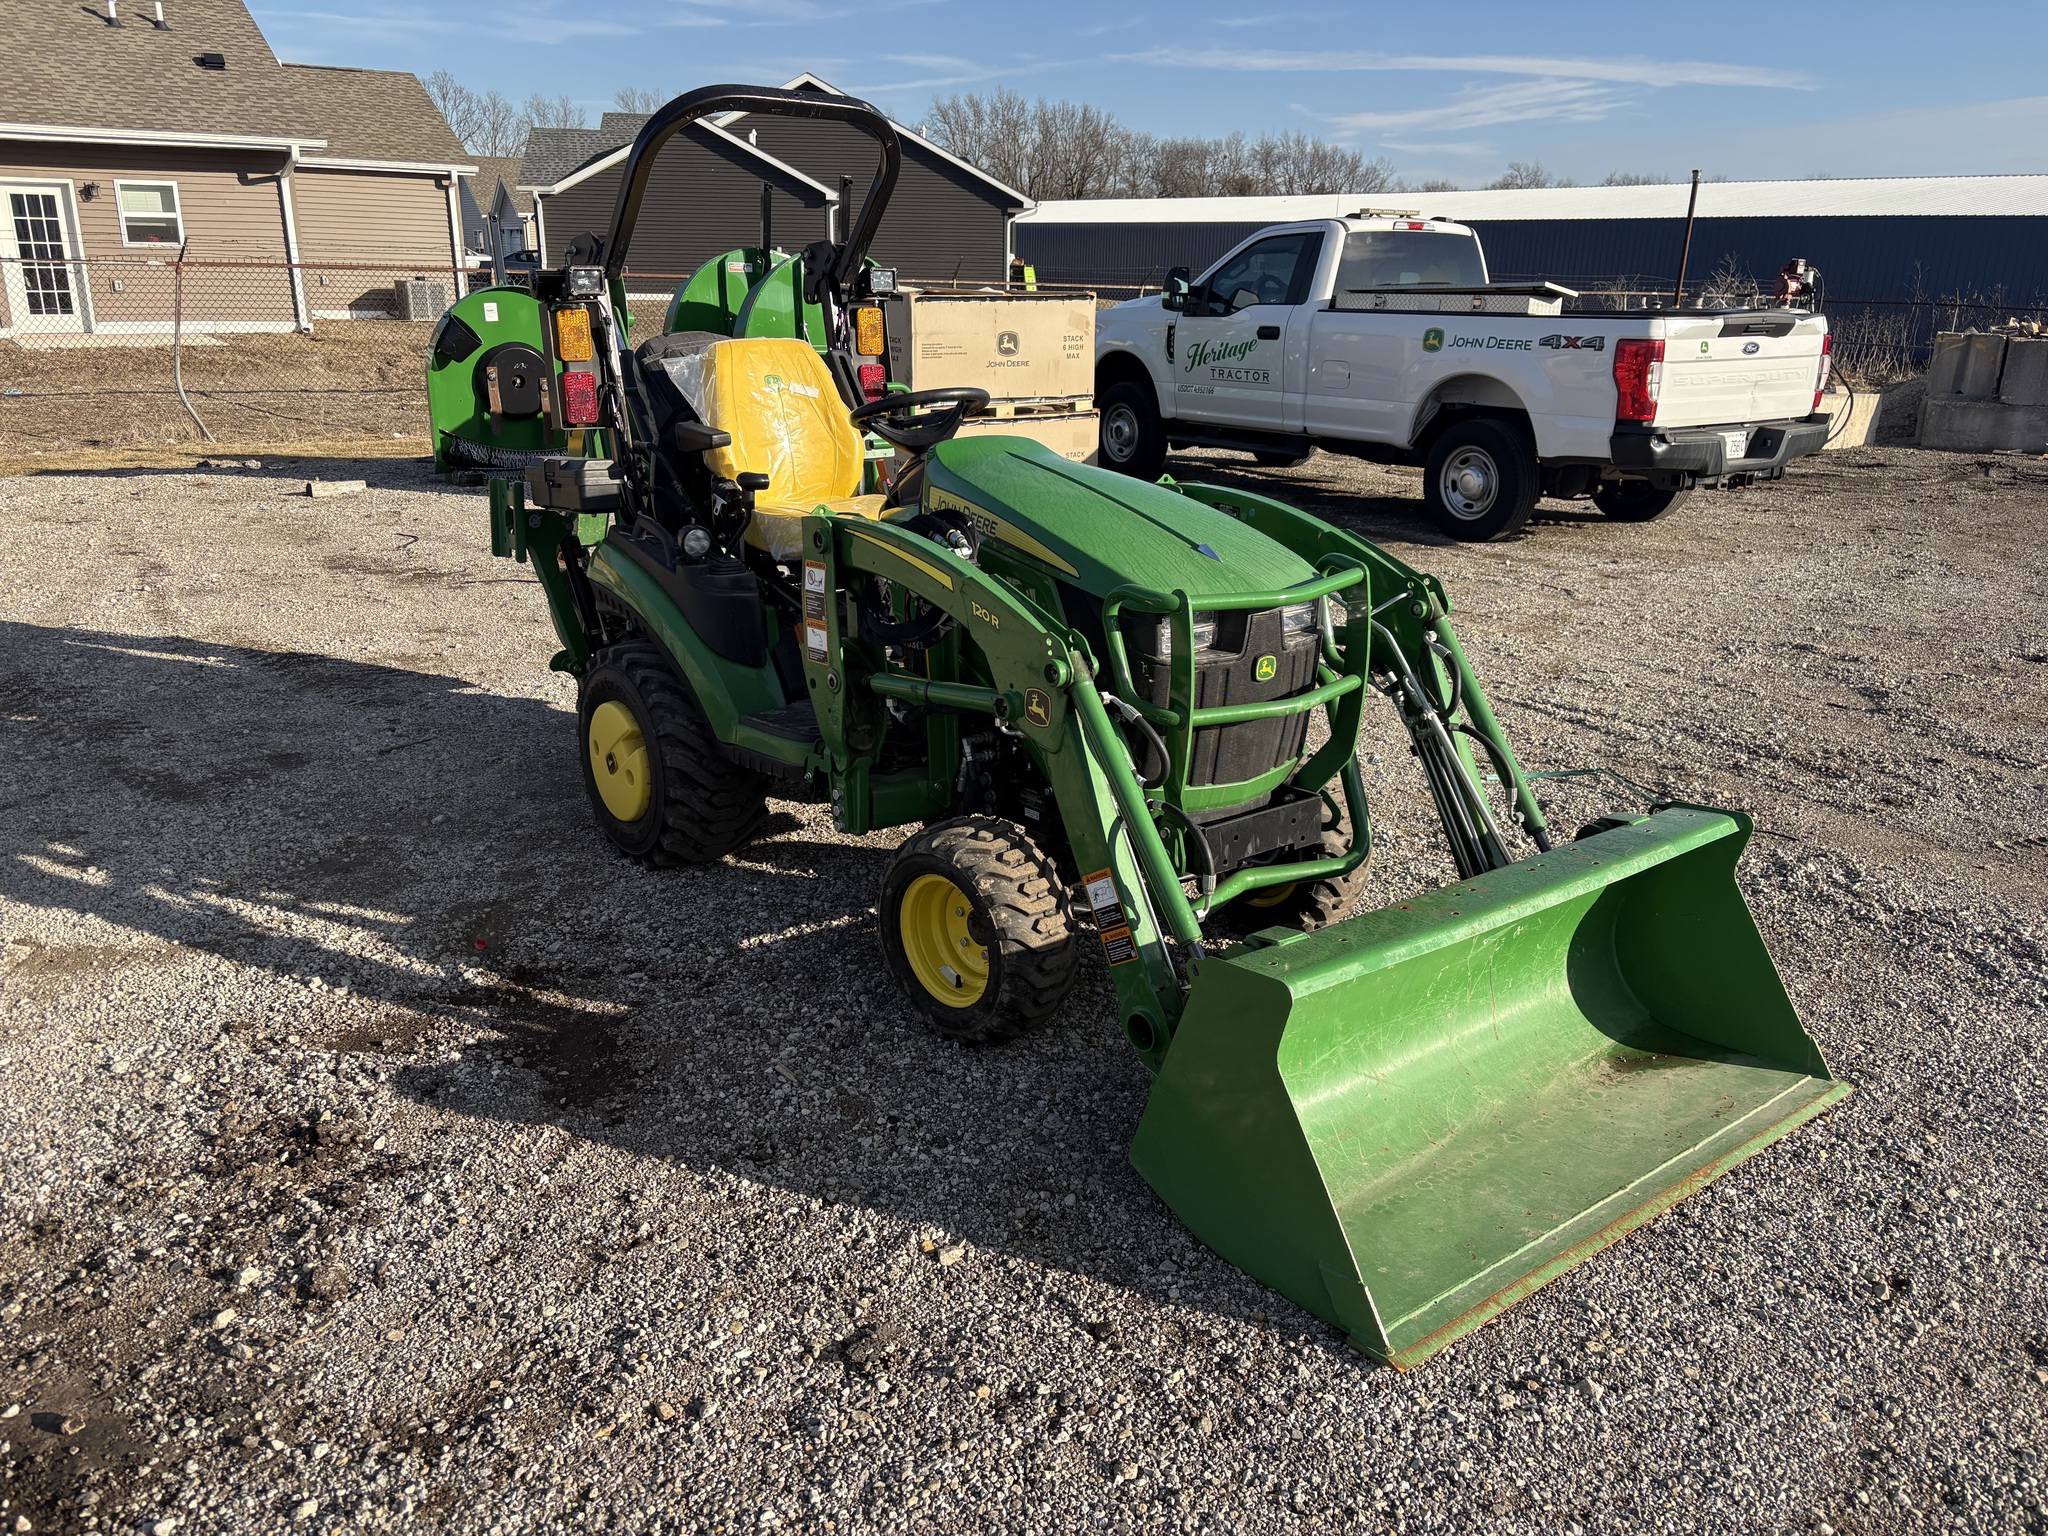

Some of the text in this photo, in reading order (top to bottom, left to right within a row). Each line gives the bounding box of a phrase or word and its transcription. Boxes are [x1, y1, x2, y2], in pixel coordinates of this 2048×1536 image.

[1448, 335, 1485, 348] JOHN
[1486, 336, 1533, 350] DEERE
[1184, 339, 1258, 373] Heritage
[986, 360, 1005, 368] JOHN
[1210, 368, 1270, 382] TRACTOR
[1177, 384, 1194, 393] USDOT
[972, 601, 1000, 630] 120 R
